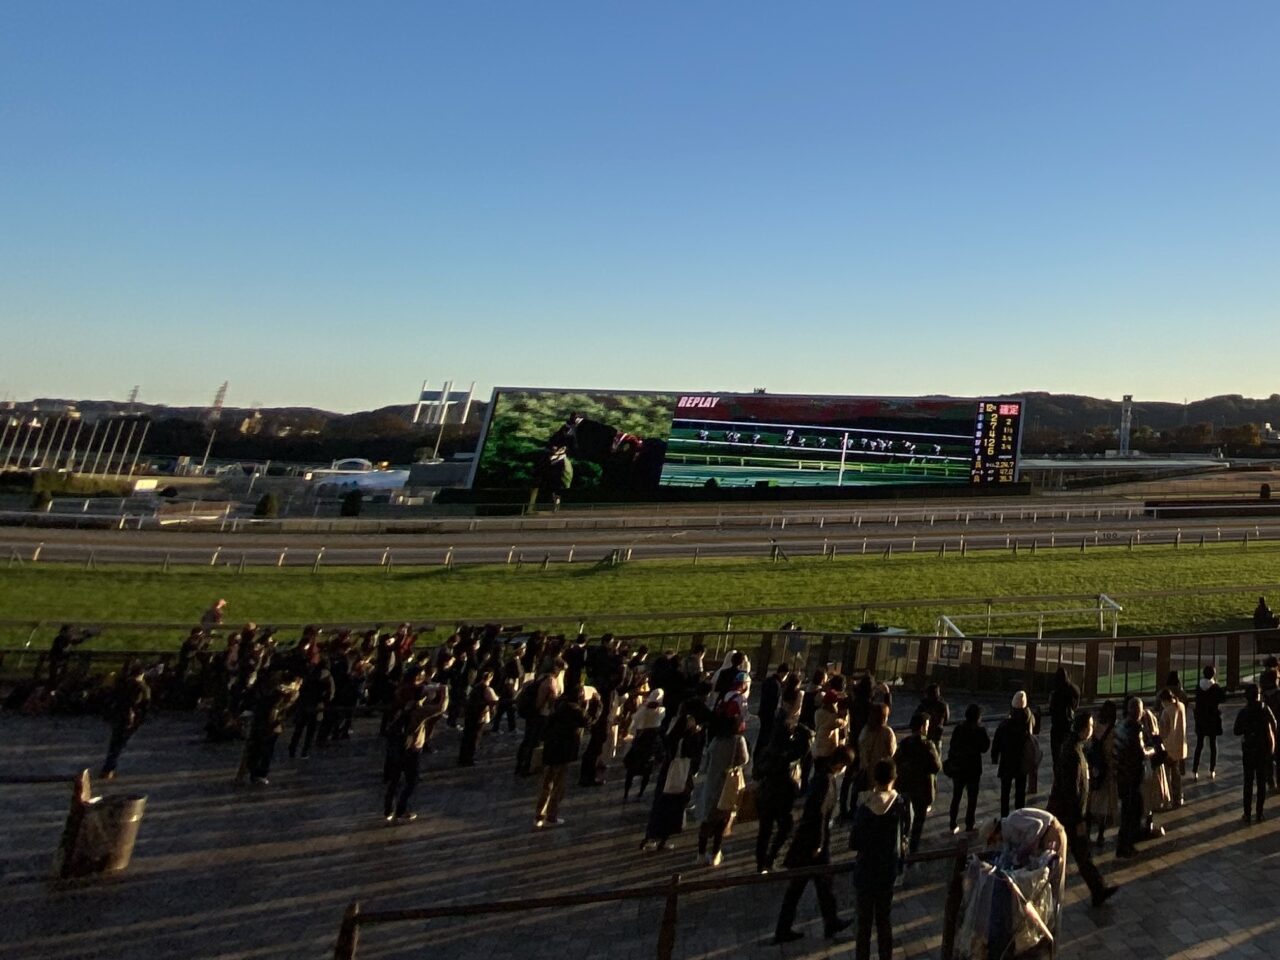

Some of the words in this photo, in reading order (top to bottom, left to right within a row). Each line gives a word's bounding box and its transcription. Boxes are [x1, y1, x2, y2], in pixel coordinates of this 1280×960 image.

[678, 396, 720, 408] REPLAY
[991, 413, 998, 421] 2
[990, 422, 997, 430] 7
[989, 430, 996, 438] 4
[984, 438, 996, 447] 12
